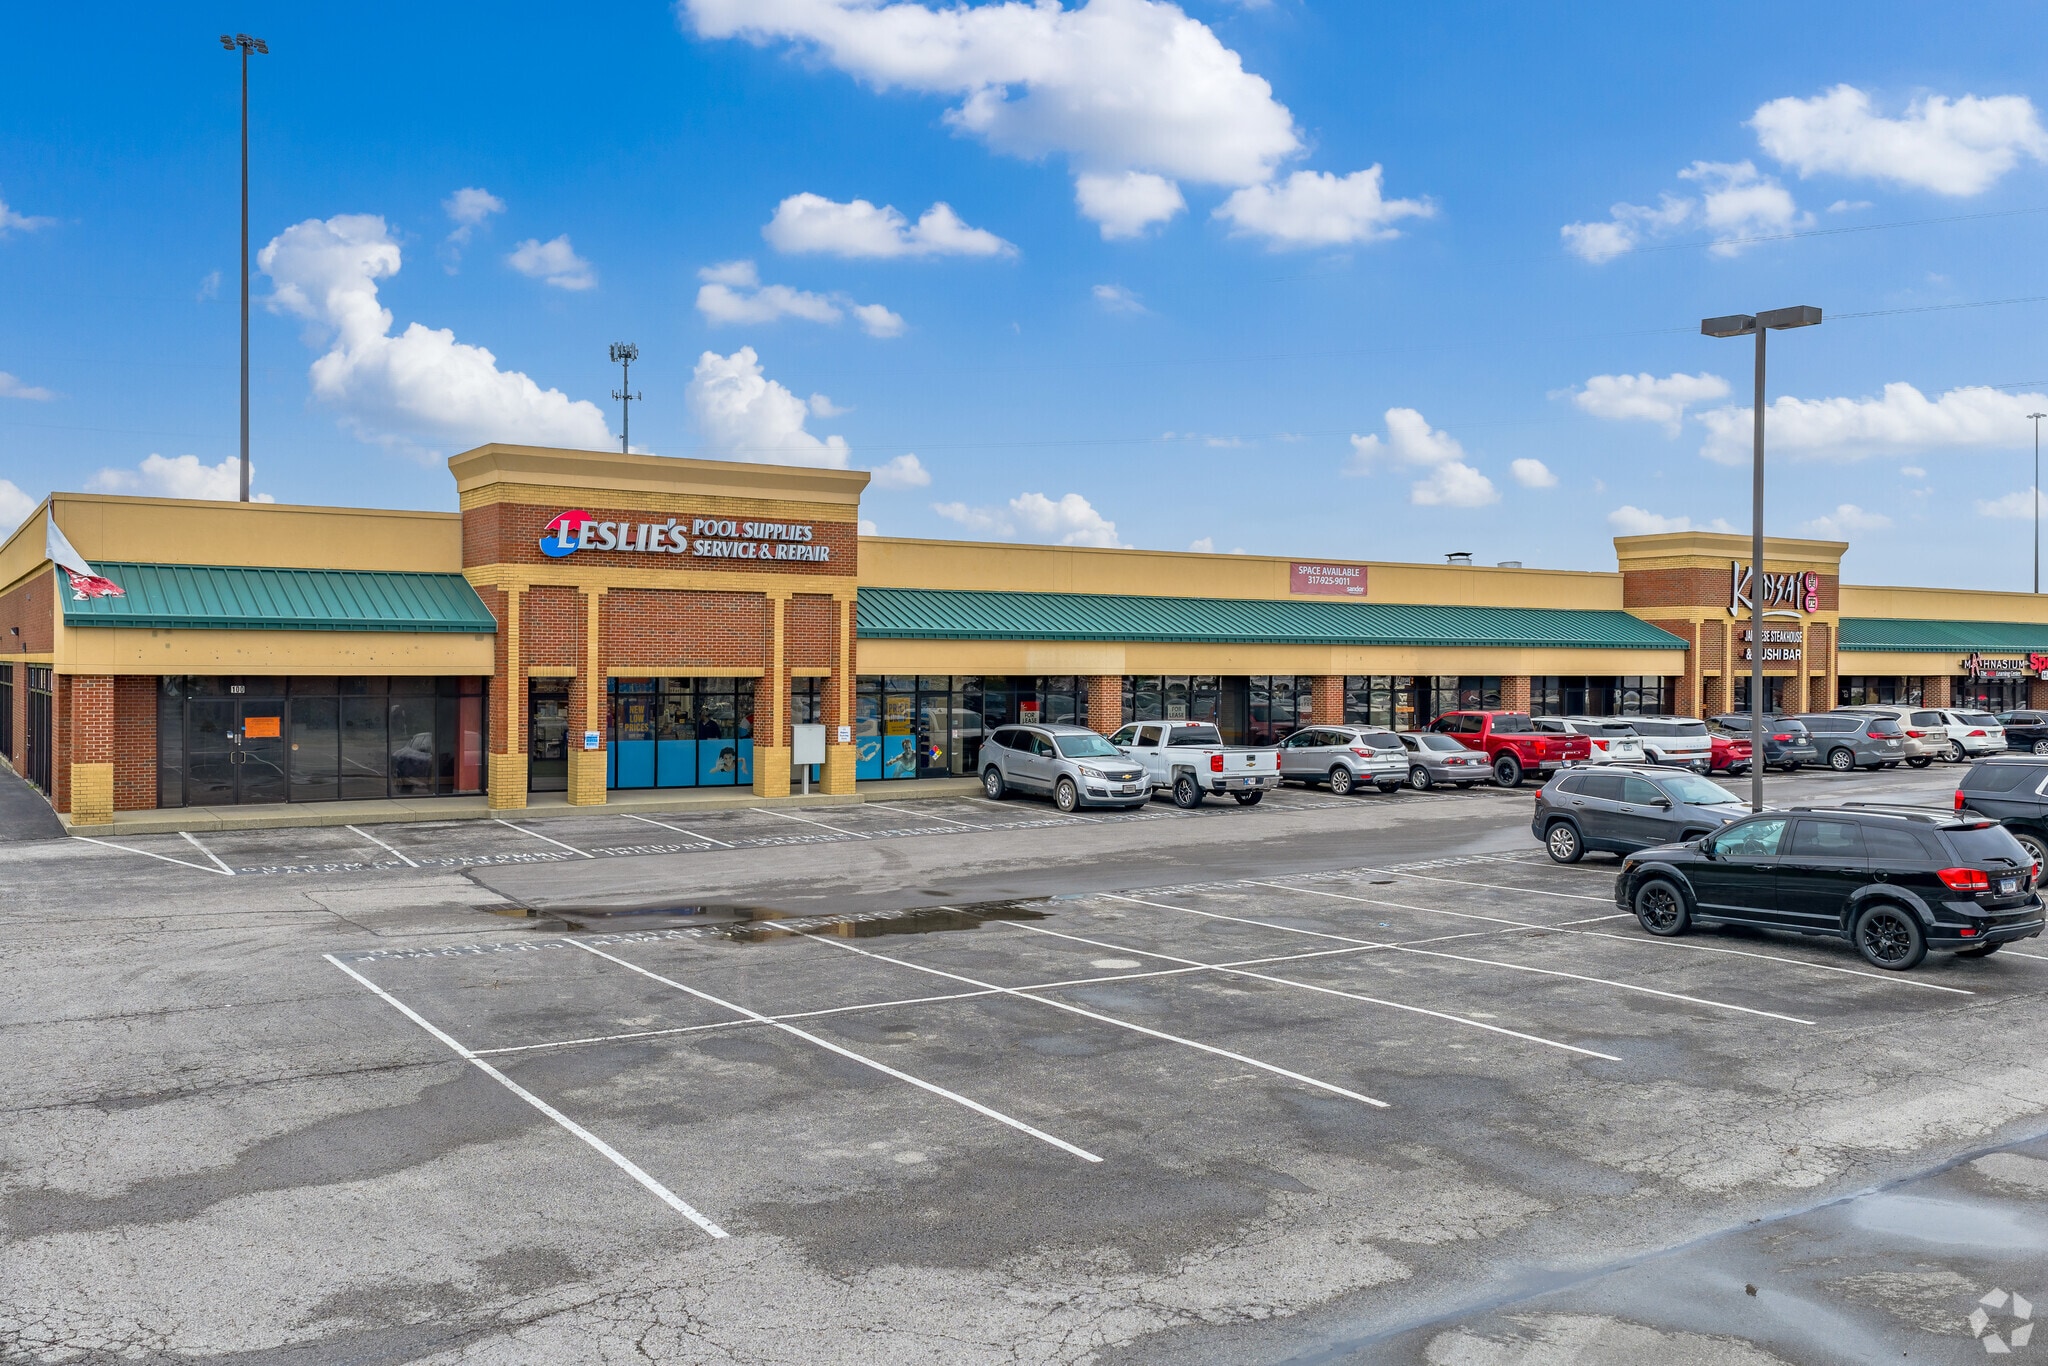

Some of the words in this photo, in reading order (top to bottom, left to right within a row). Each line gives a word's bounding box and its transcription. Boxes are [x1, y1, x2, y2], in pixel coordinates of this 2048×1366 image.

[557, 518, 688, 554] LESLIE'S
[692, 518, 740, 538] POOL
[742, 521, 813, 542] SUPPLIES
[693, 539, 758, 559] SERVICE
[759, 544, 773, 560] &
[775, 544, 830, 562] REPAIR
[1298, 566, 1321, 575] SPACE
[1322, 567, 1360, 577] AVAILABLE
[1308, 576, 1350, 586] 317-925-9011
[1727, 561, 1804, 618] KNSAI
[1745, 630, 1771, 642] JAESE
[1770, 631, 1802, 643] STEAKHOUSE
[1761, 649, 1782, 660] USHI
[1783, 649, 1802, 661] BAR
[629, 705, 645, 714] NEW
[629, 714, 645, 722] LOW
[624, 723, 649, 732] PRICES
